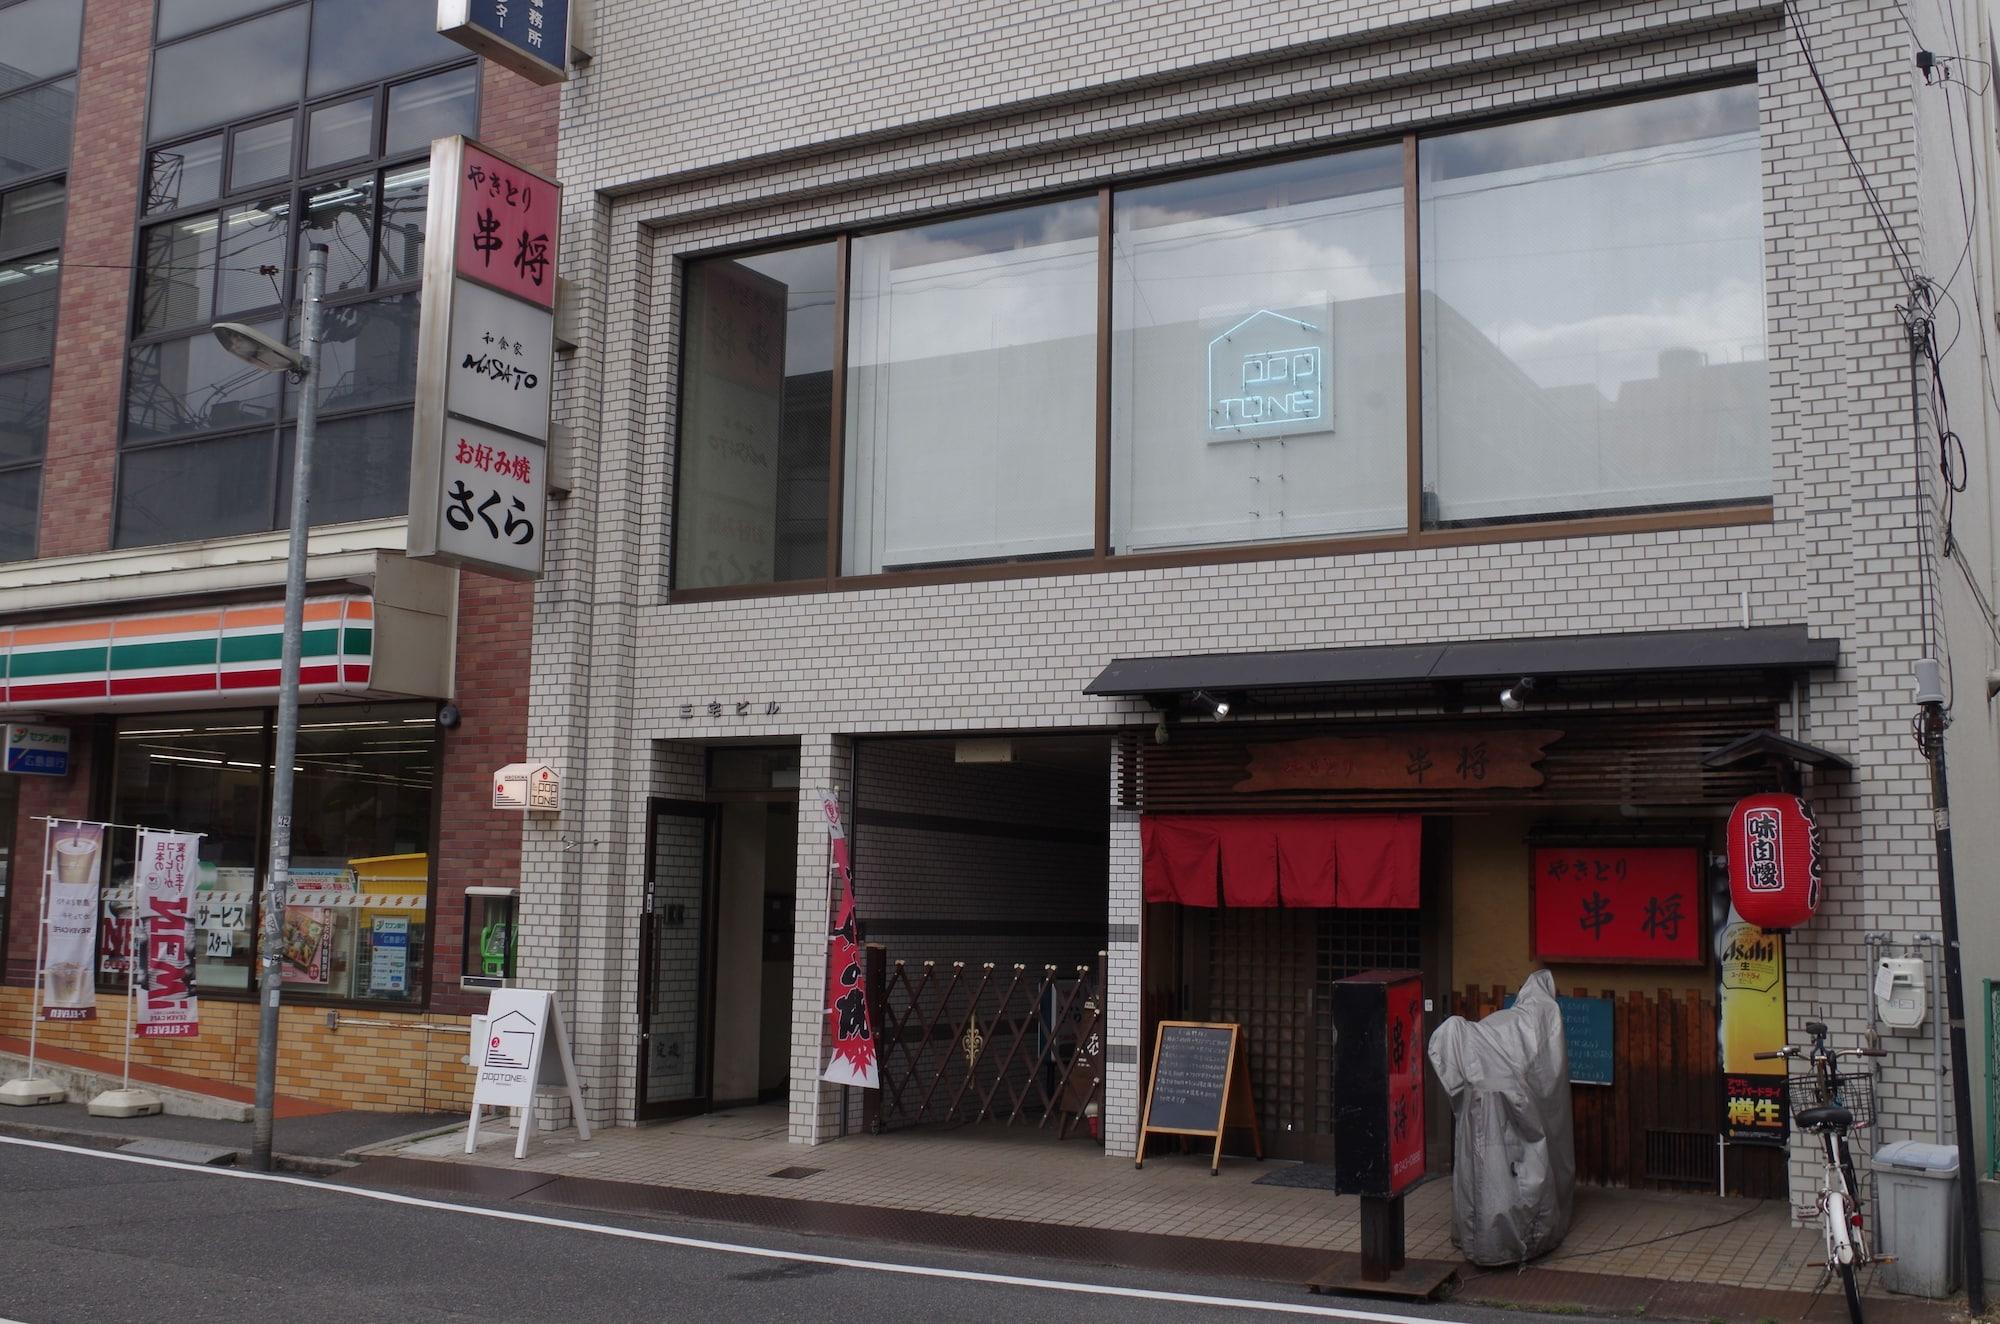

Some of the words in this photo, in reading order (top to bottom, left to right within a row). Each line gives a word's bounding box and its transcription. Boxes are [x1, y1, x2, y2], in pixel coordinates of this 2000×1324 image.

[496, 0, 508, 28] ター
[467, 164, 531, 213] やきとり
[473, 207, 550, 286] 串将
[462, 353, 538, 390] MASATO
[1219, 389, 1315, 421] TONE
[455, 438, 531, 484] お好み焼
[446, 480, 534, 545] さくら
[680, 701, 779, 719] 三宅ビル
[1407, 741, 1490, 784] 串将
[1748, 812, 1778, 887] 味自慢
[1547, 857, 1628, 881] やきとり
[200, 905, 244, 928] サービス
[1580, 890, 1687, 941] 串将
[209, 932, 232, 954] スタート
[1723, 940, 1773, 962] Asahi
[1741, 962, 1750, 971] 生
[1727, 1087, 1783, 1098] スーパードライ
[1728, 1097, 1784, 1127] 樽生
